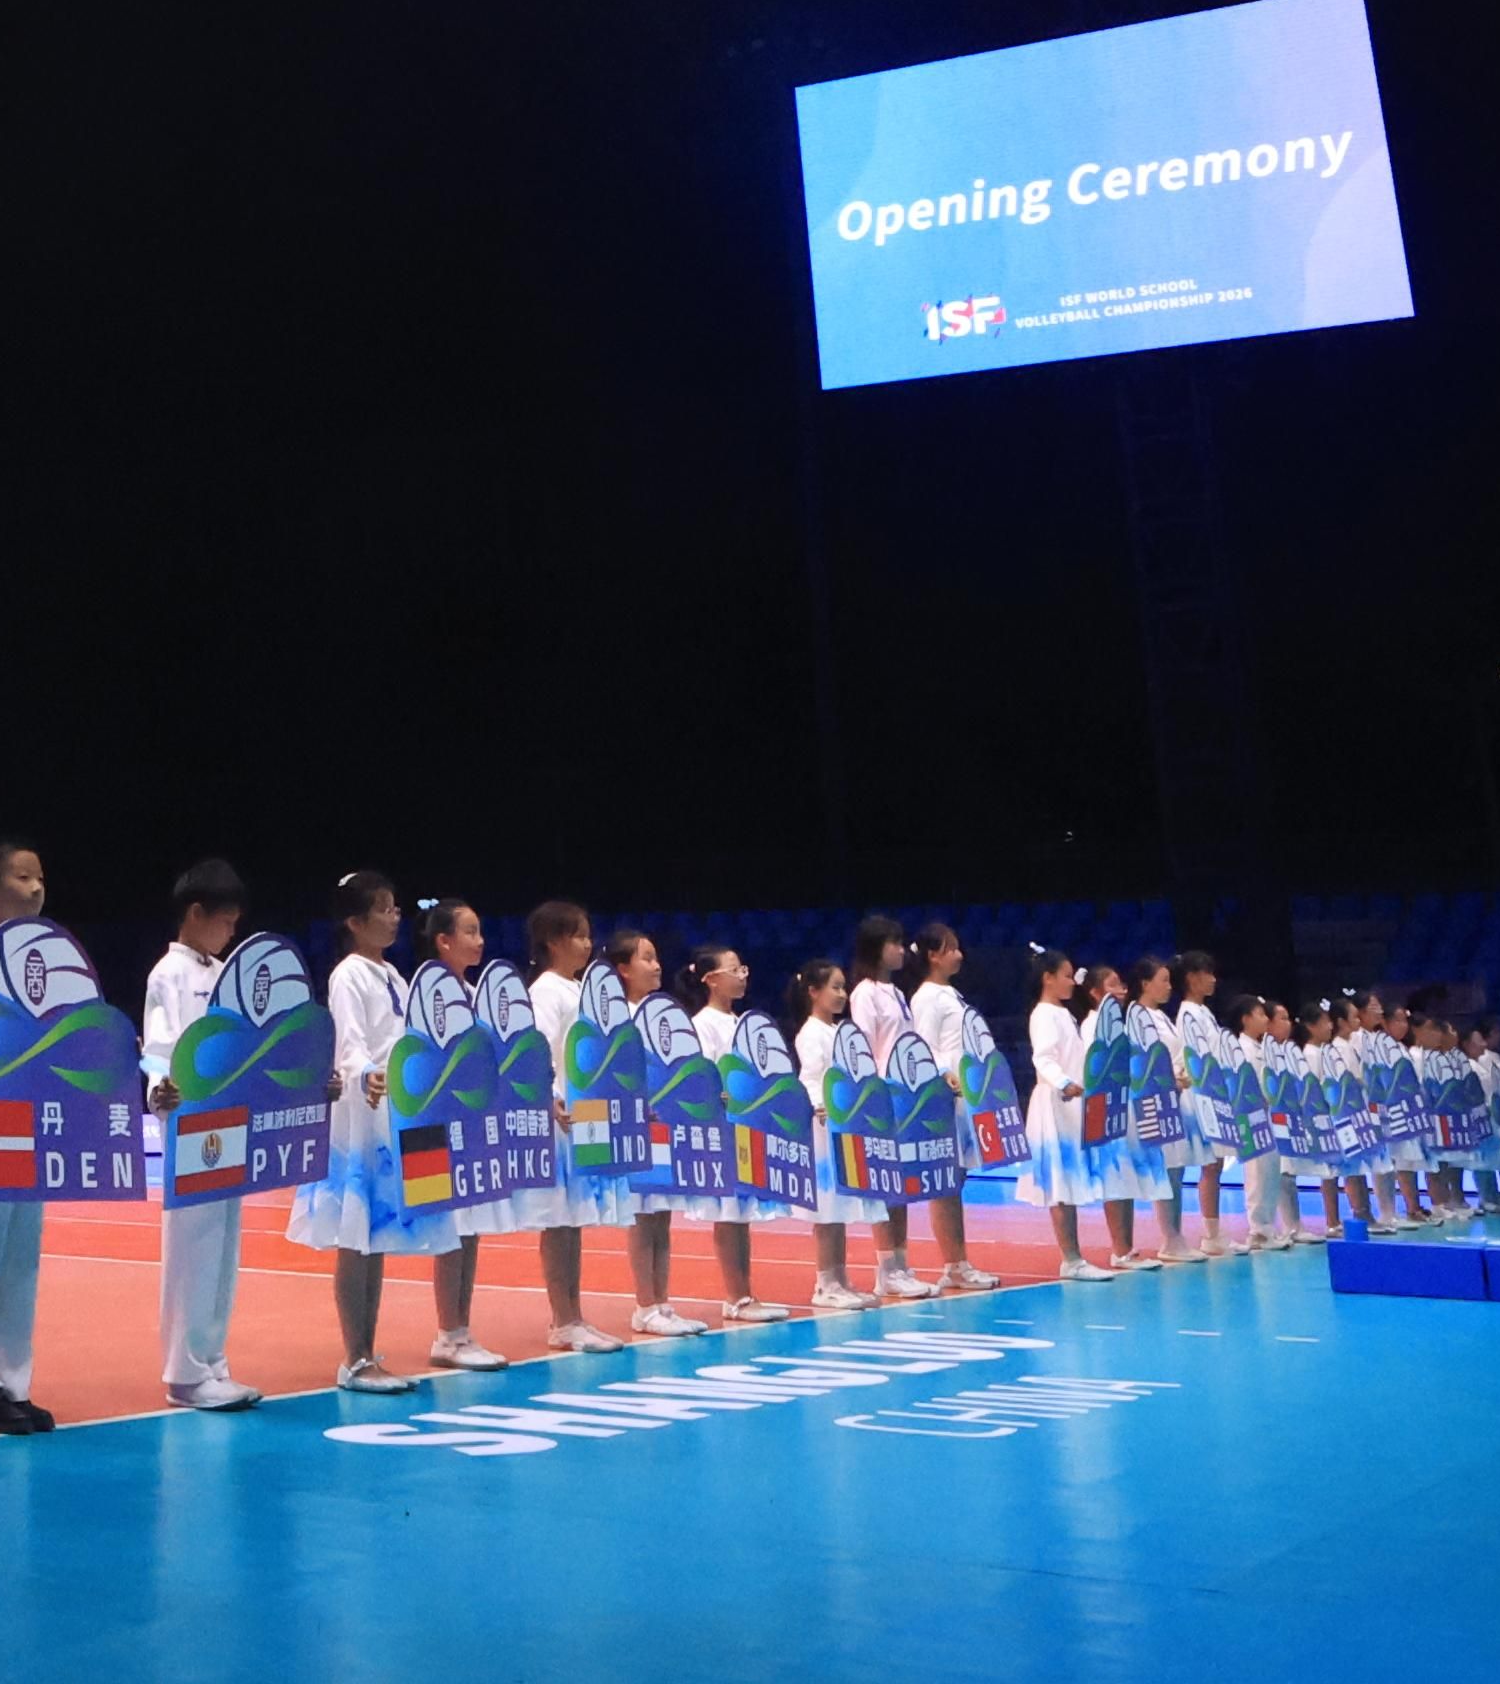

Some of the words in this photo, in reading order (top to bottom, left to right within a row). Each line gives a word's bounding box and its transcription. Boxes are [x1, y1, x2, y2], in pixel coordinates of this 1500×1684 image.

[836, 178, 1052, 247] Opening
[1067, 131, 1354, 206] Ceremony
[1015, 308, 1100, 330] VOLLEYBALL
[1104, 293, 1214, 317] CHAMPIONSHIP
[1218, 287, 1253, 304] 2026
[1060, 293, 1082, 308] ISF
[1084, 287, 1135, 305] WORLD
[1139, 279, 1198, 298] SCHOOL
[926, 296, 1001, 341] ISF
[42, 1101, 132, 1137] 丹麦
[505, 1110, 550, 1137] 中国香港
[252, 1140, 316, 1182] PYF
[507, 1148, 551, 1179] HKG
[613, 1135, 645, 1163] IND
[1002, 1133, 1027, 1158] TUR
[46, 1151, 133, 1189] DEN
[455, 1158, 502, 1197] GER
[677, 1160, 724, 1188] LUX
[769, 1167, 814, 1203] MDA
[869, 1167, 902, 1194] ROU
[922, 1166, 956, 1192] SVK
[323, 1331, 1056, 1456] SHANGLUO
[833, 1376, 1181, 1438] CHINA
